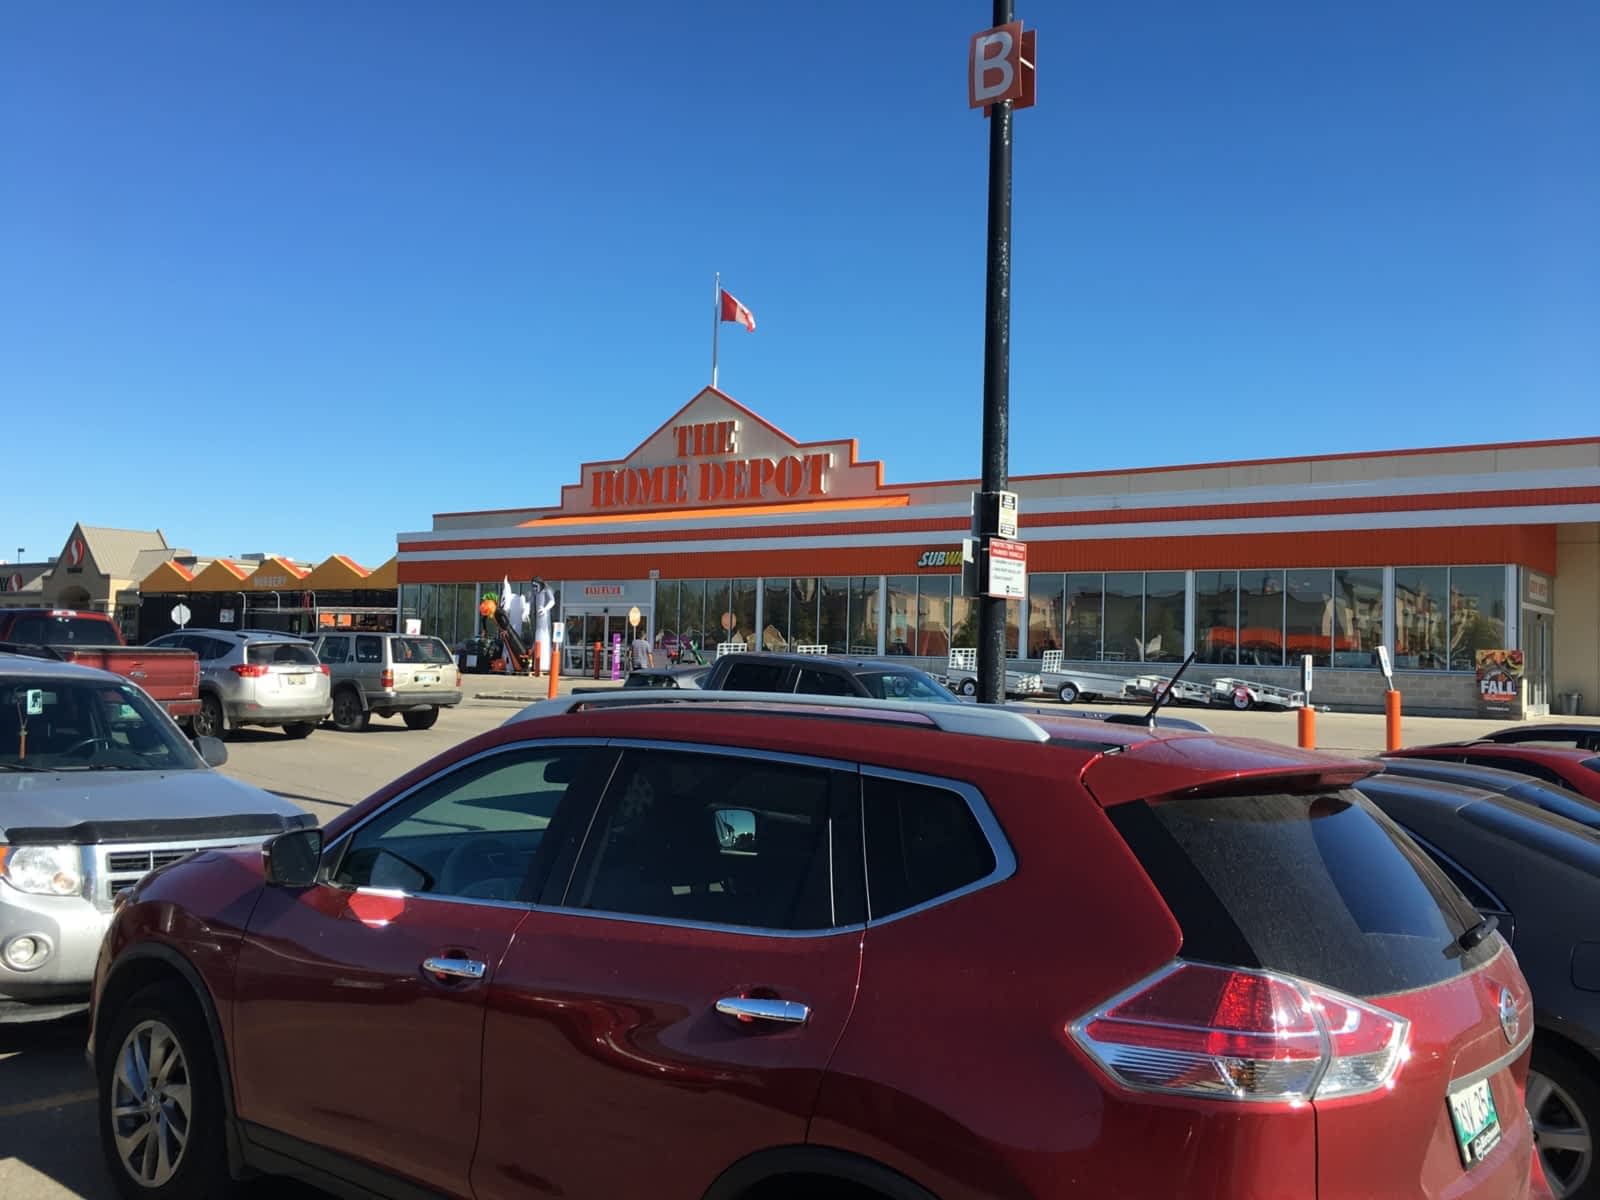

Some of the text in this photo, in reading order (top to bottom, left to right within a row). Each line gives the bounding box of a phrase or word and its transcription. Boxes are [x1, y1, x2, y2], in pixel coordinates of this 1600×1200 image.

[975, 31, 1014, 101] B
[673, 420, 740, 458] THE
[592, 453, 834, 508] HOME DEPOT
[918, 551, 962, 566] SUBWA
[1480, 680, 1517, 695] FALL
